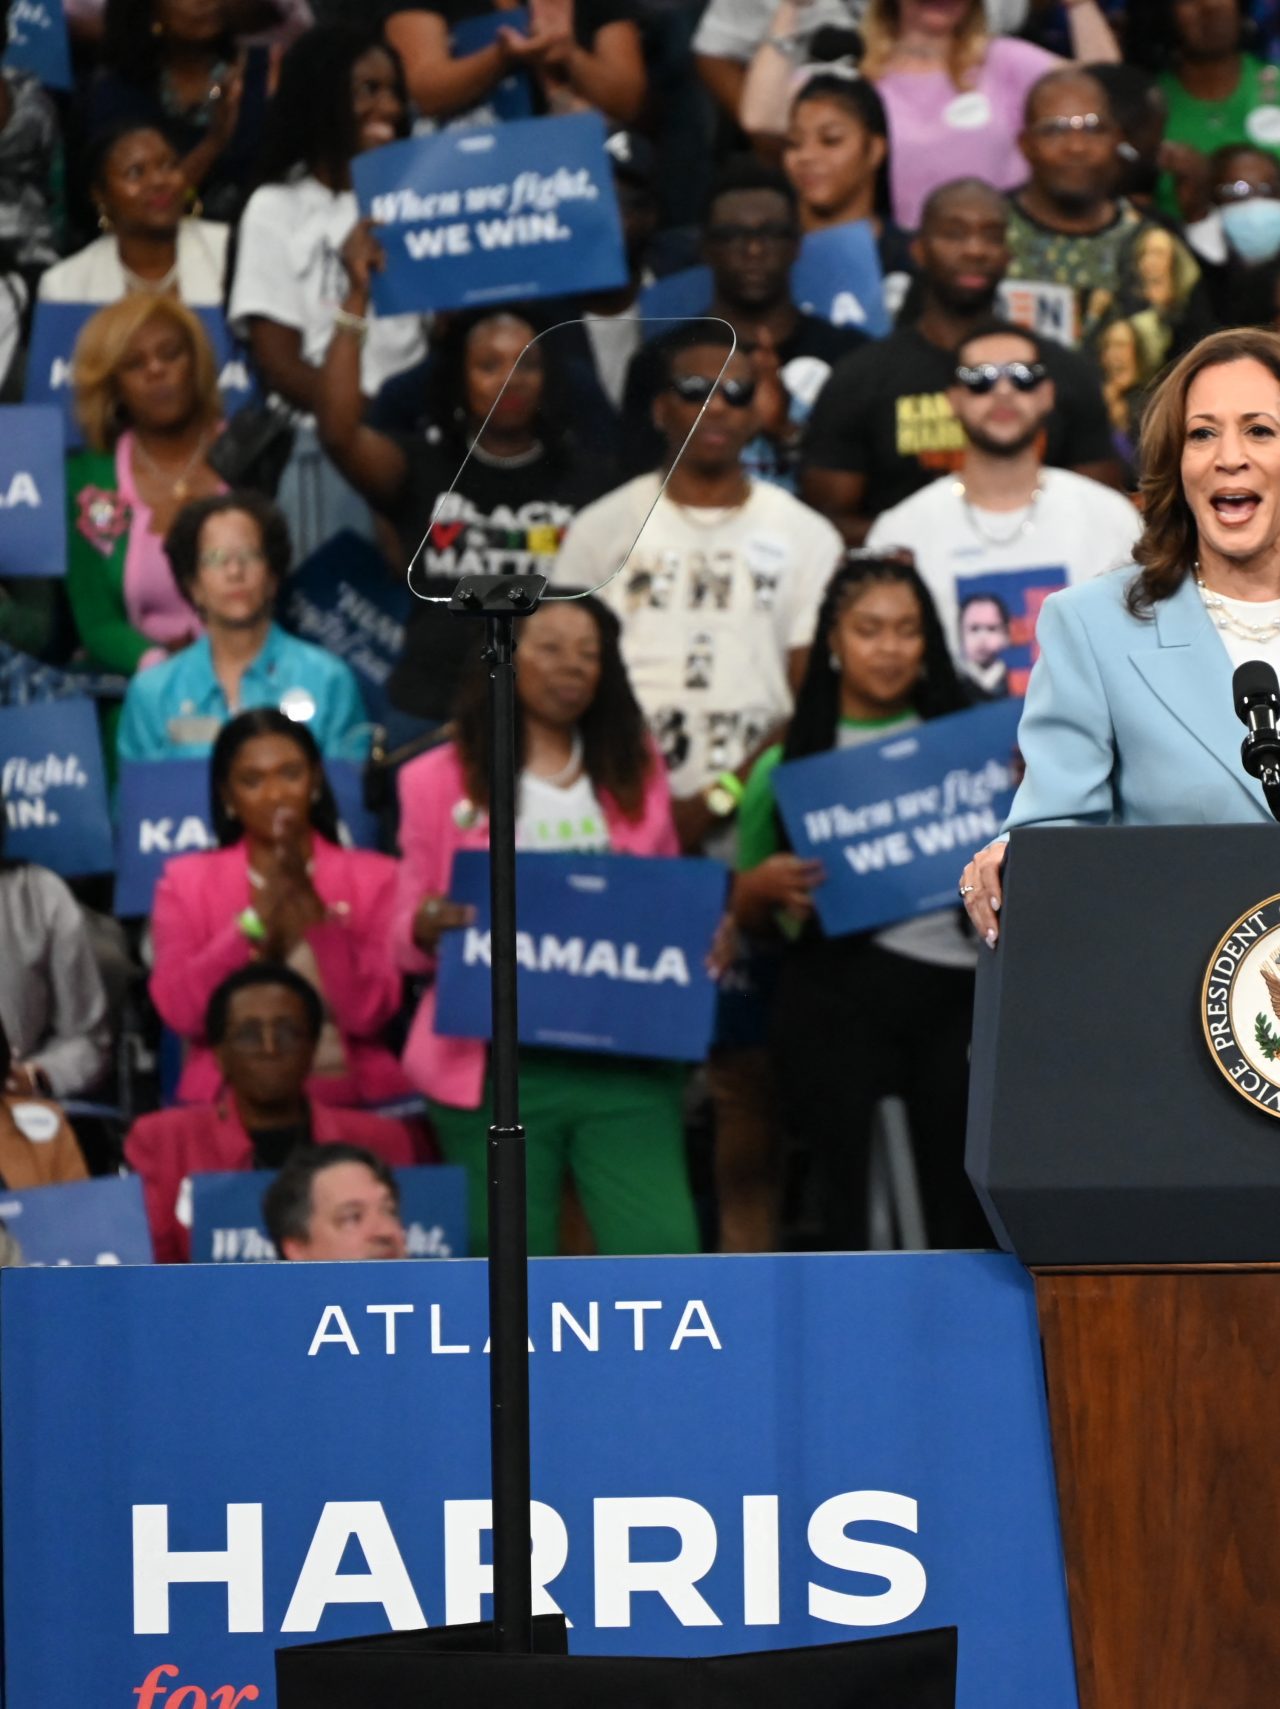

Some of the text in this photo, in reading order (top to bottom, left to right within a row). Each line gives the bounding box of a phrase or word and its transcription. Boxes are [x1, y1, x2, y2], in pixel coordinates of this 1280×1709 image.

[371, 167, 599, 225] When we fight,
[404, 211, 573, 261] WE WIN.
[1, 754, 88, 798] fight,
[804, 803, 894, 844] When
[895, 785, 940, 821] we
[844, 831, 914, 875] WE
[463, 926, 690, 986] KAMALA
[1207, 910, 1264, 1051] PRESIDENT
[131, 1489, 928, 1635] HARRIS
[130, 1663, 258, 1709] for
